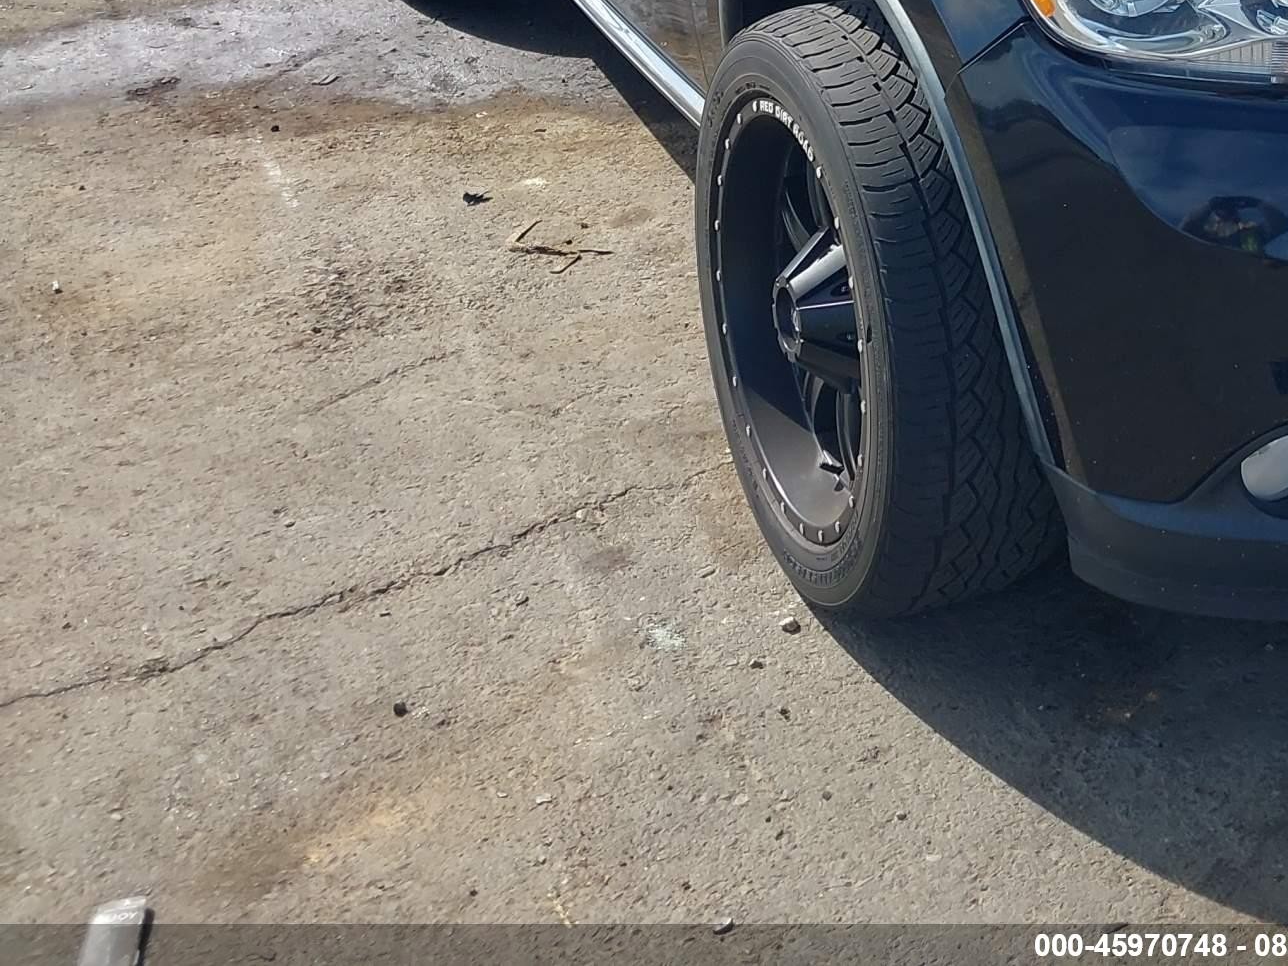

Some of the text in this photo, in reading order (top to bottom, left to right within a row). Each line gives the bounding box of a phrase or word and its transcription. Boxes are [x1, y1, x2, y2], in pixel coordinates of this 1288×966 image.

[759, 100, 815, 162] RED DIRT ROAD
